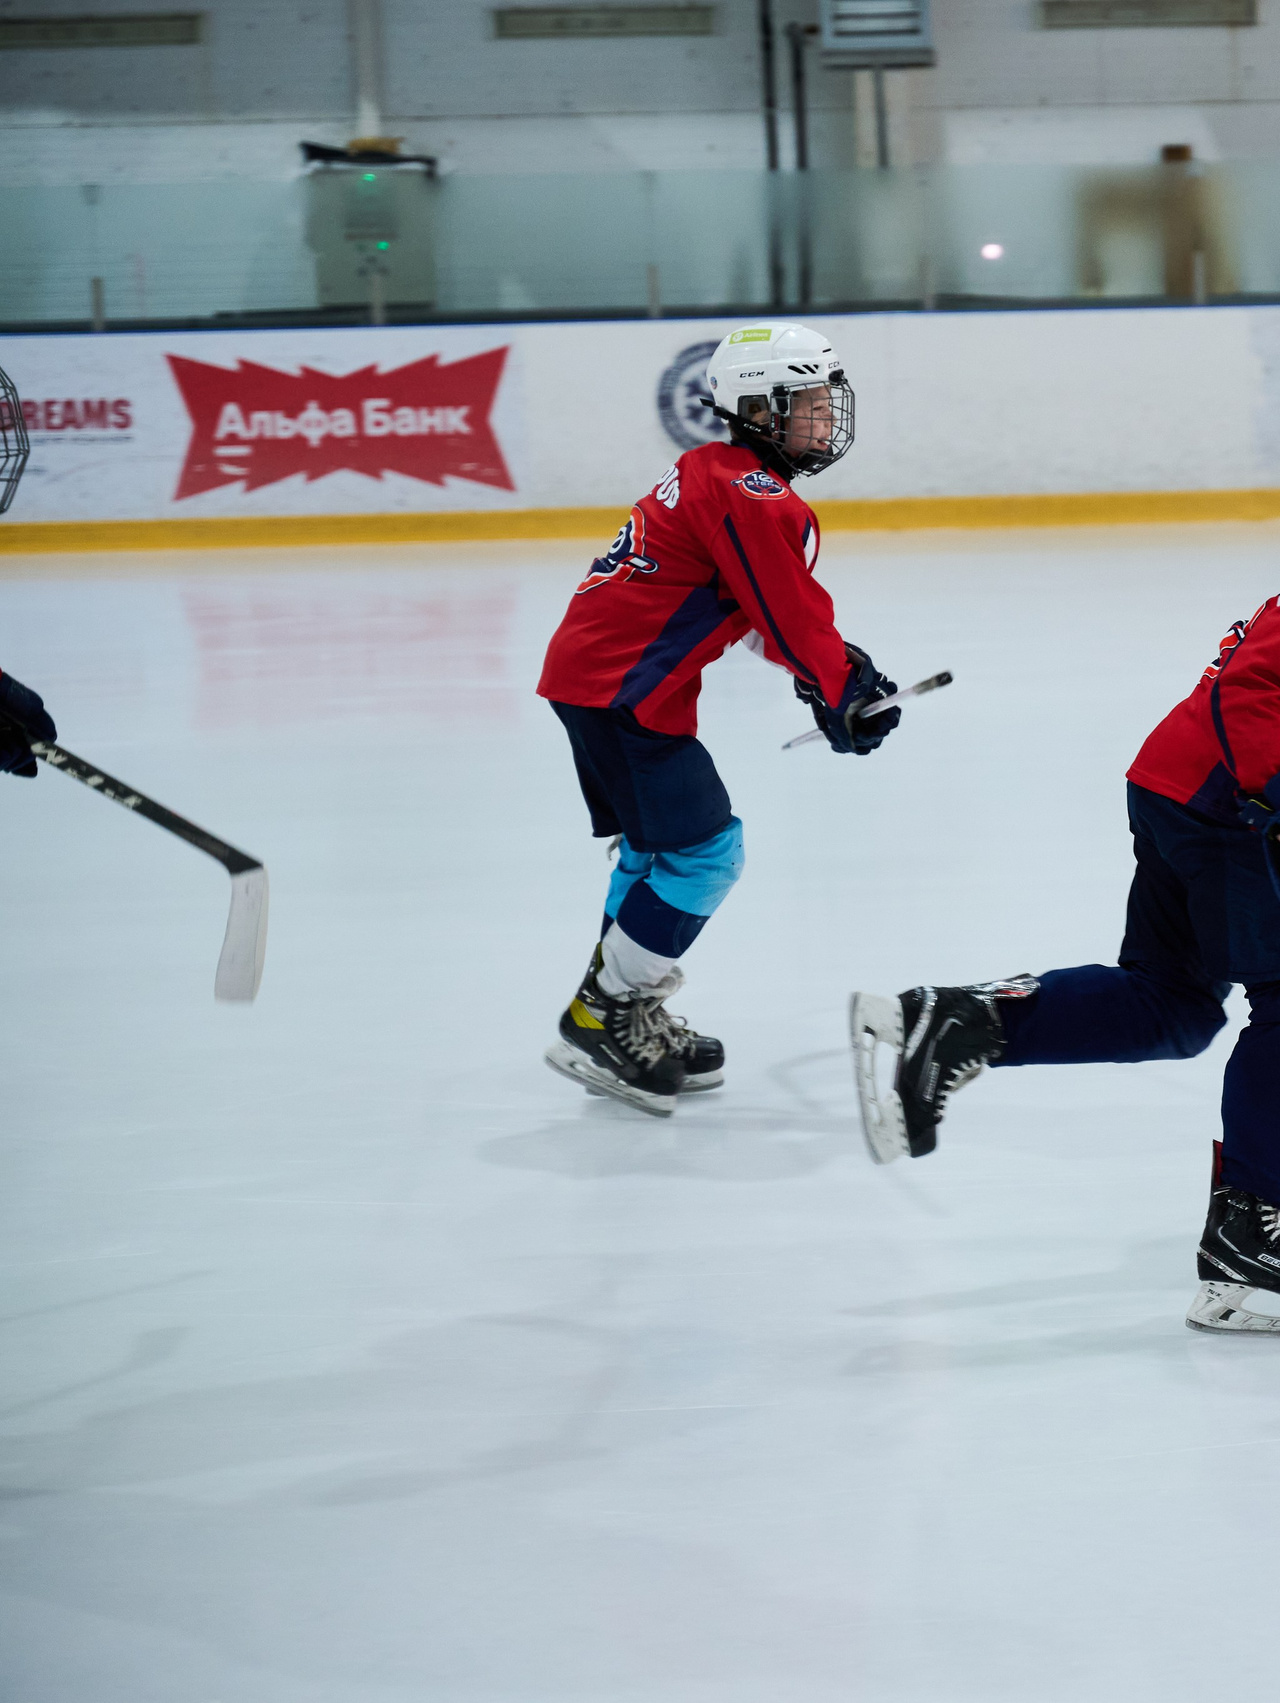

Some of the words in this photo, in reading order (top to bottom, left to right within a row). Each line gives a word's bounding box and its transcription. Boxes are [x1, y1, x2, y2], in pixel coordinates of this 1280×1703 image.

[739, 370, 765, 378] CCM
[214, 401, 357, 447] Альфа
[362, 397, 471, 436] Банк
[743, 423, 762, 432] CCM
